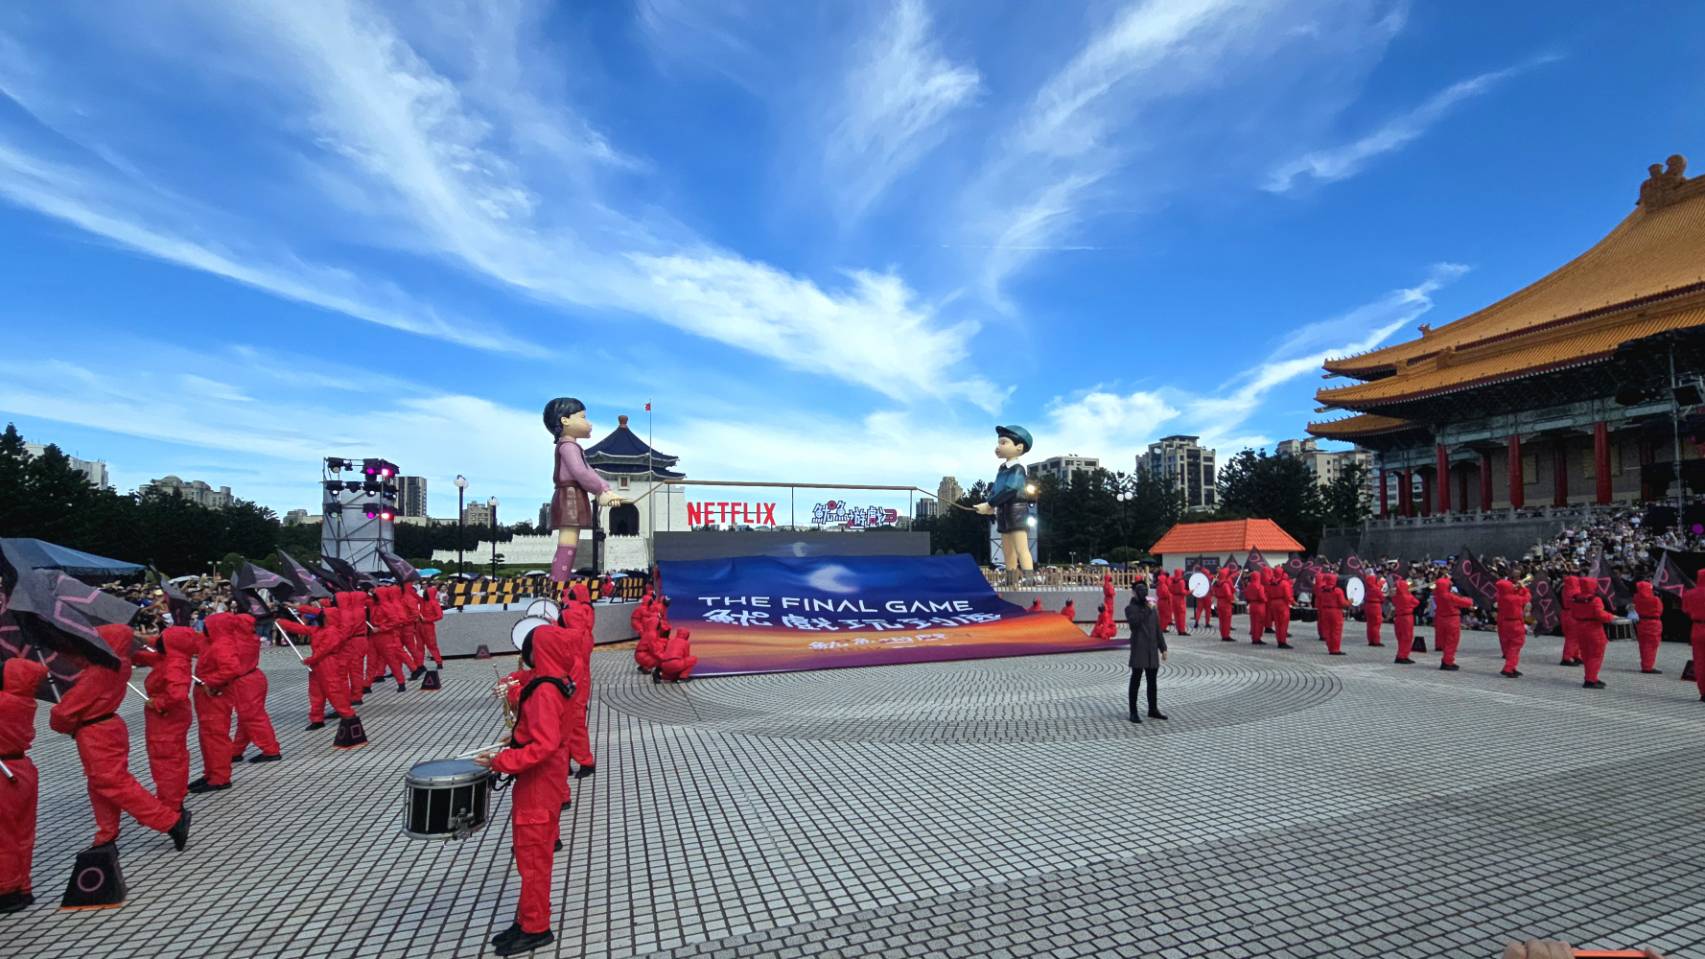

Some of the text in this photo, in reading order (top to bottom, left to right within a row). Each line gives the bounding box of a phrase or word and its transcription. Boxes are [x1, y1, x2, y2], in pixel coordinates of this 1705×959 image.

[687, 502, 776, 526] NETFLIX
[698, 596, 973, 613] THE FINAL GAME
